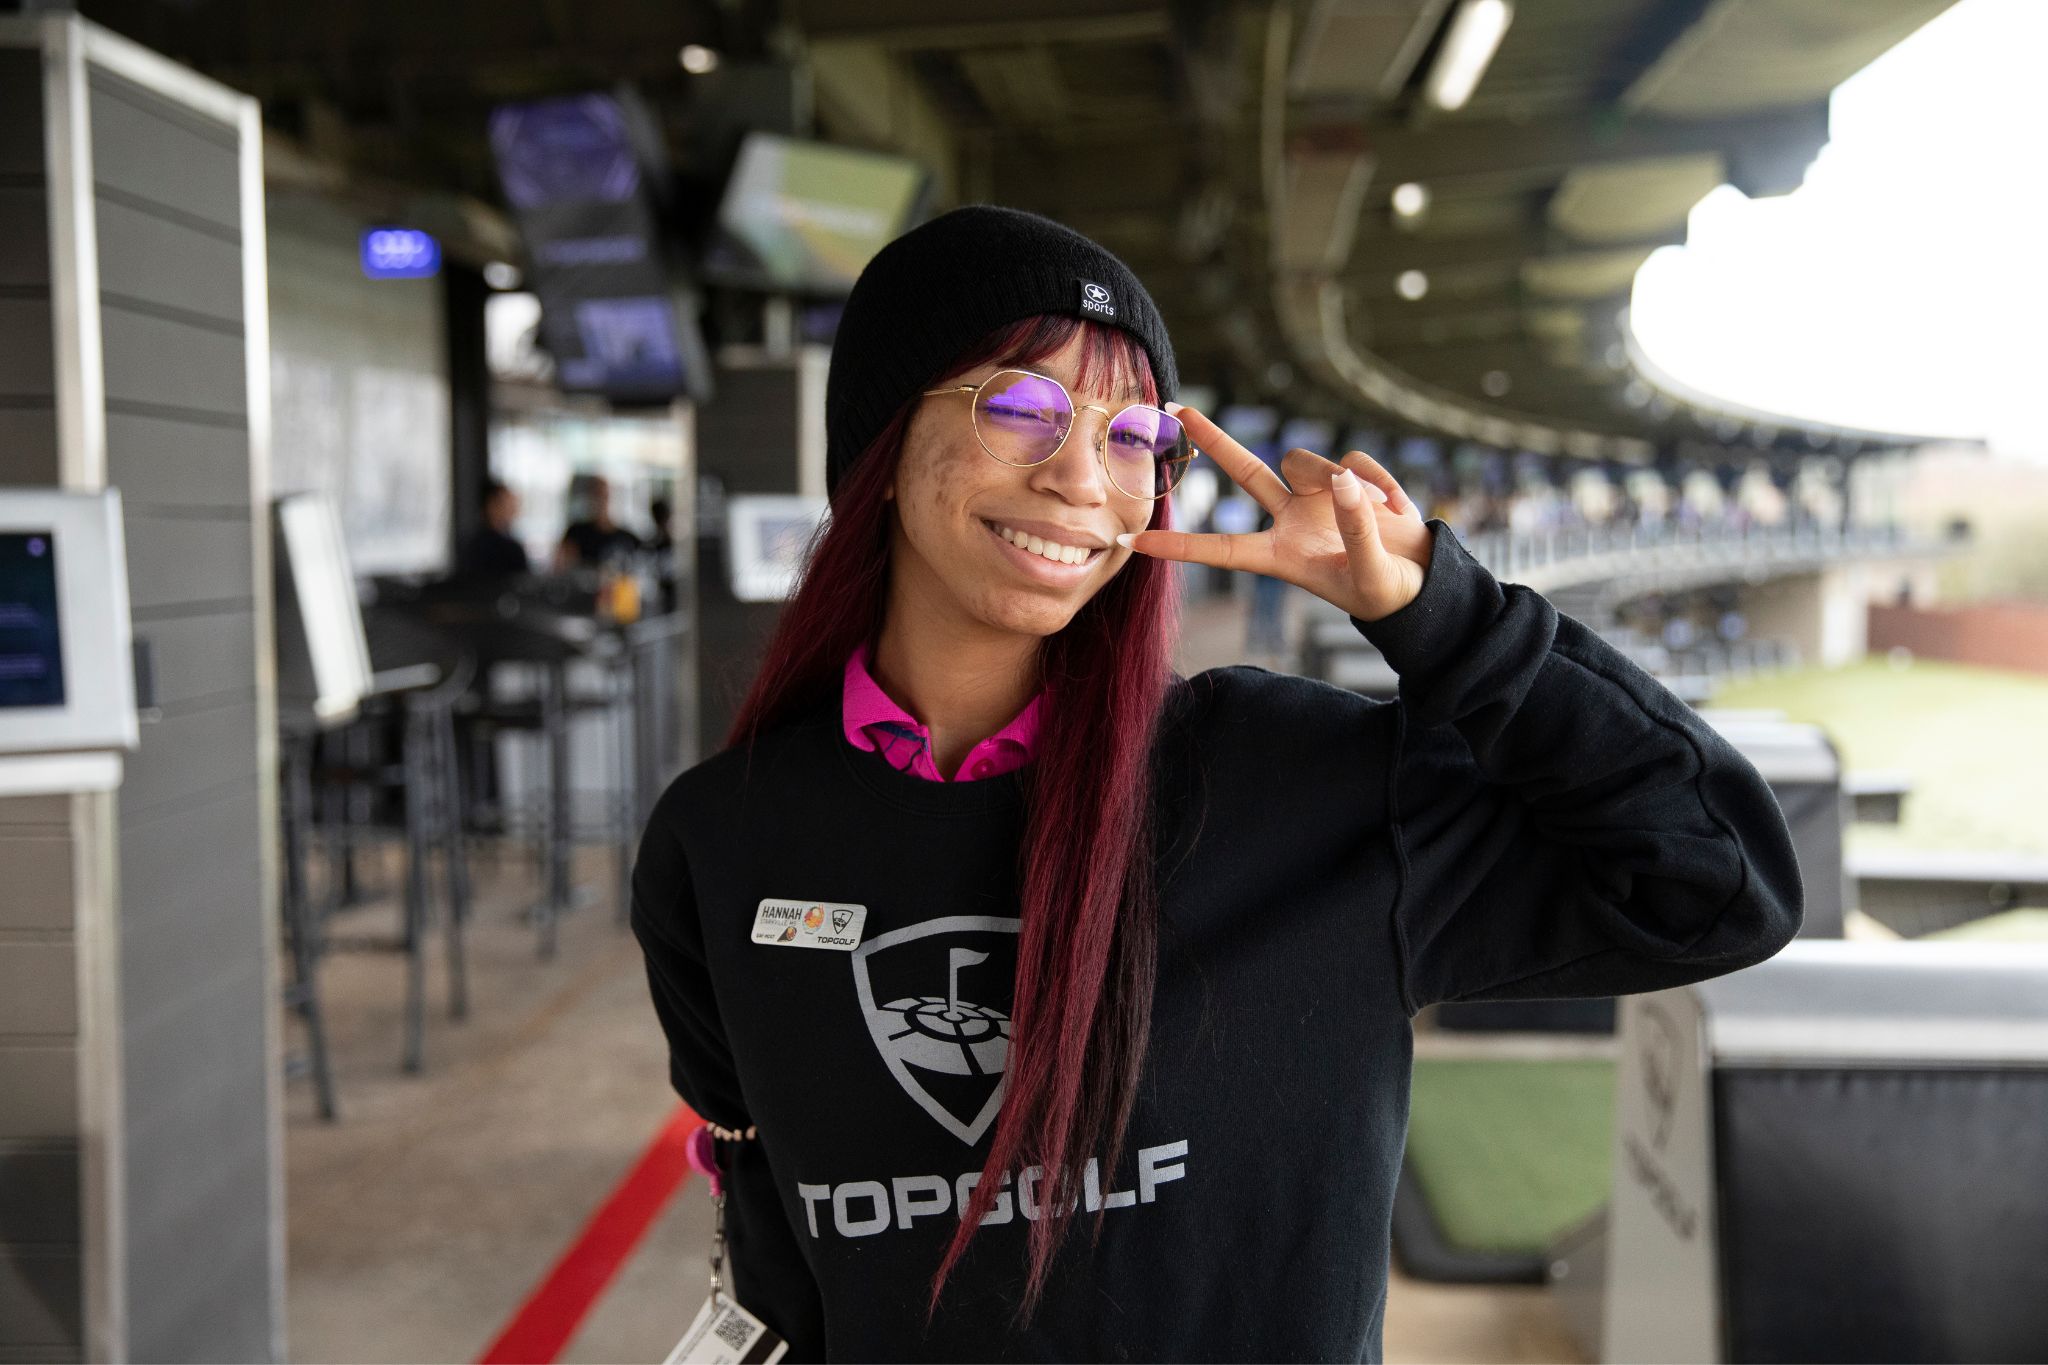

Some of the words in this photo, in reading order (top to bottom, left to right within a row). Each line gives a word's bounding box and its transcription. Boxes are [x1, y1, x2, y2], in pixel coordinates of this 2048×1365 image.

[1083, 299, 1114, 316] sports
[762, 905, 803, 920] HANNAH
[817, 936, 856, 946] TOPGOLF
[797, 1139, 1189, 1239] TOPGOLF
